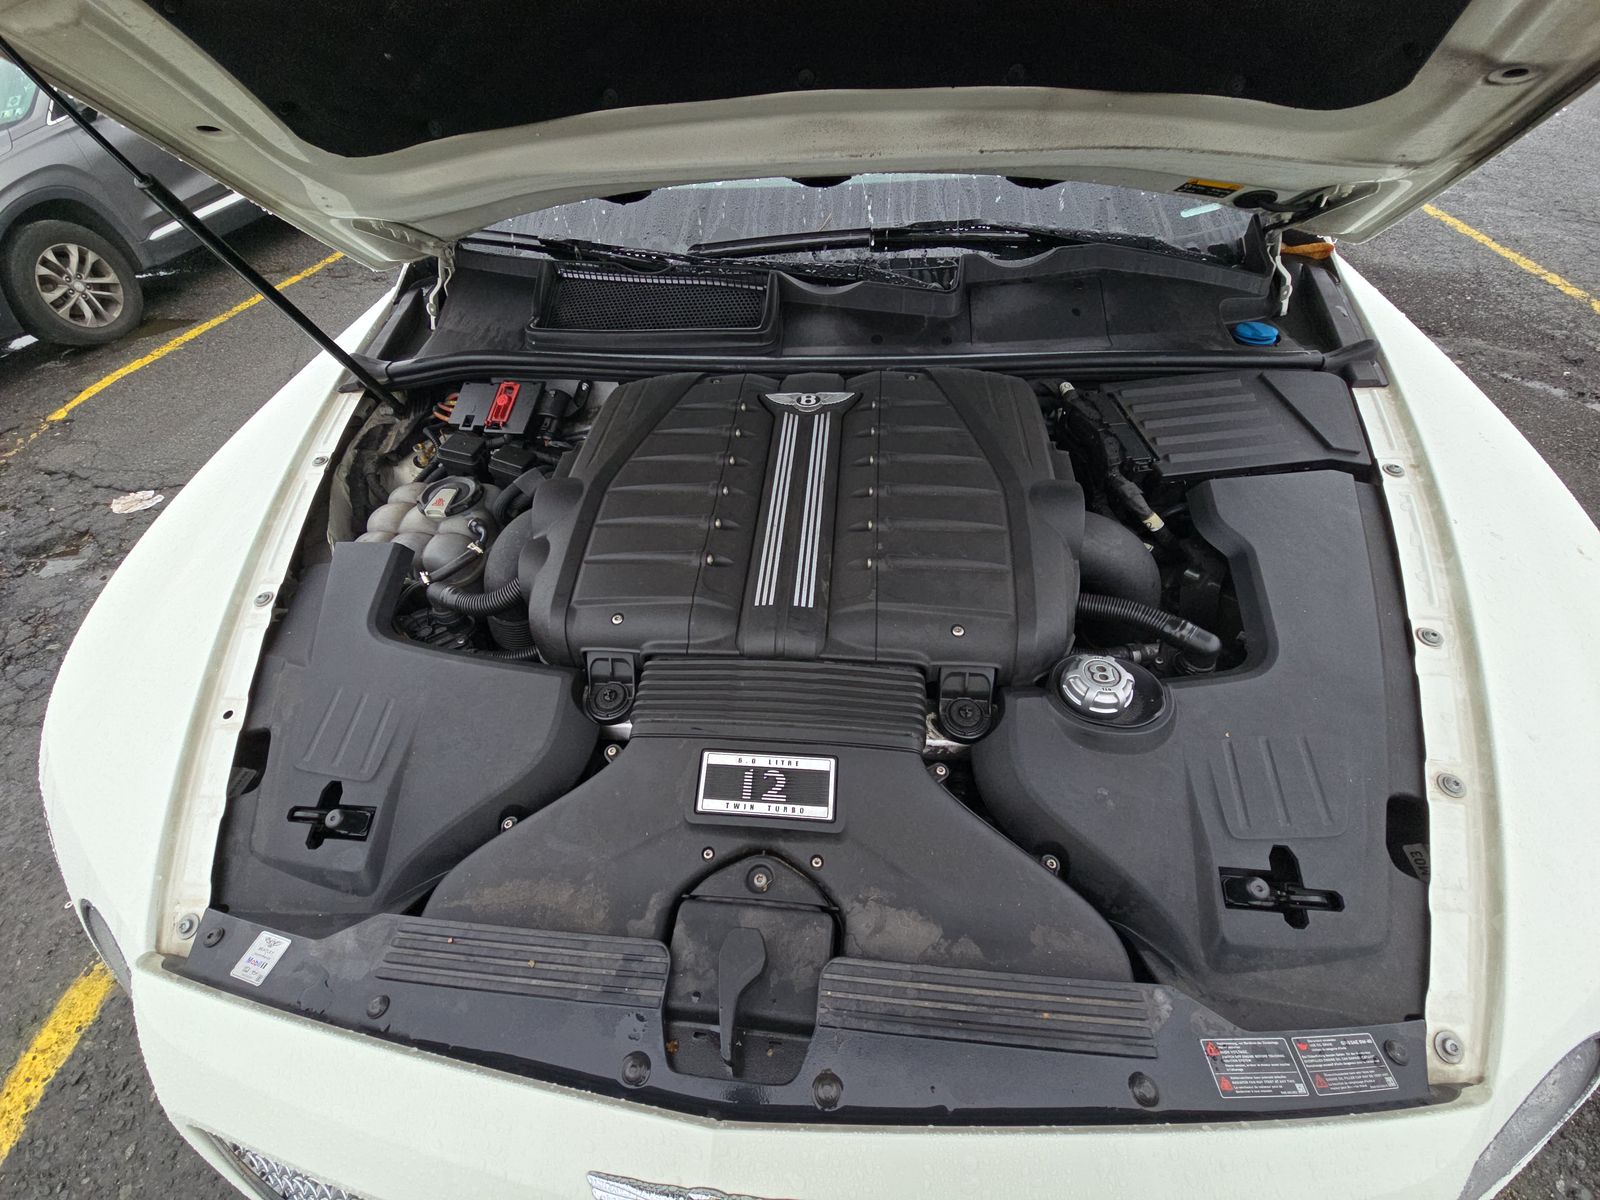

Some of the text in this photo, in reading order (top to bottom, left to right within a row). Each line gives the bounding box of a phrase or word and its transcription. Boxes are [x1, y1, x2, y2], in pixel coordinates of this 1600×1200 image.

[800, 395, 816, 405] B
[768, 759, 799, 767] LITRE
[742, 768, 787, 802] 12
[767, 802, 805, 812] TURBO
